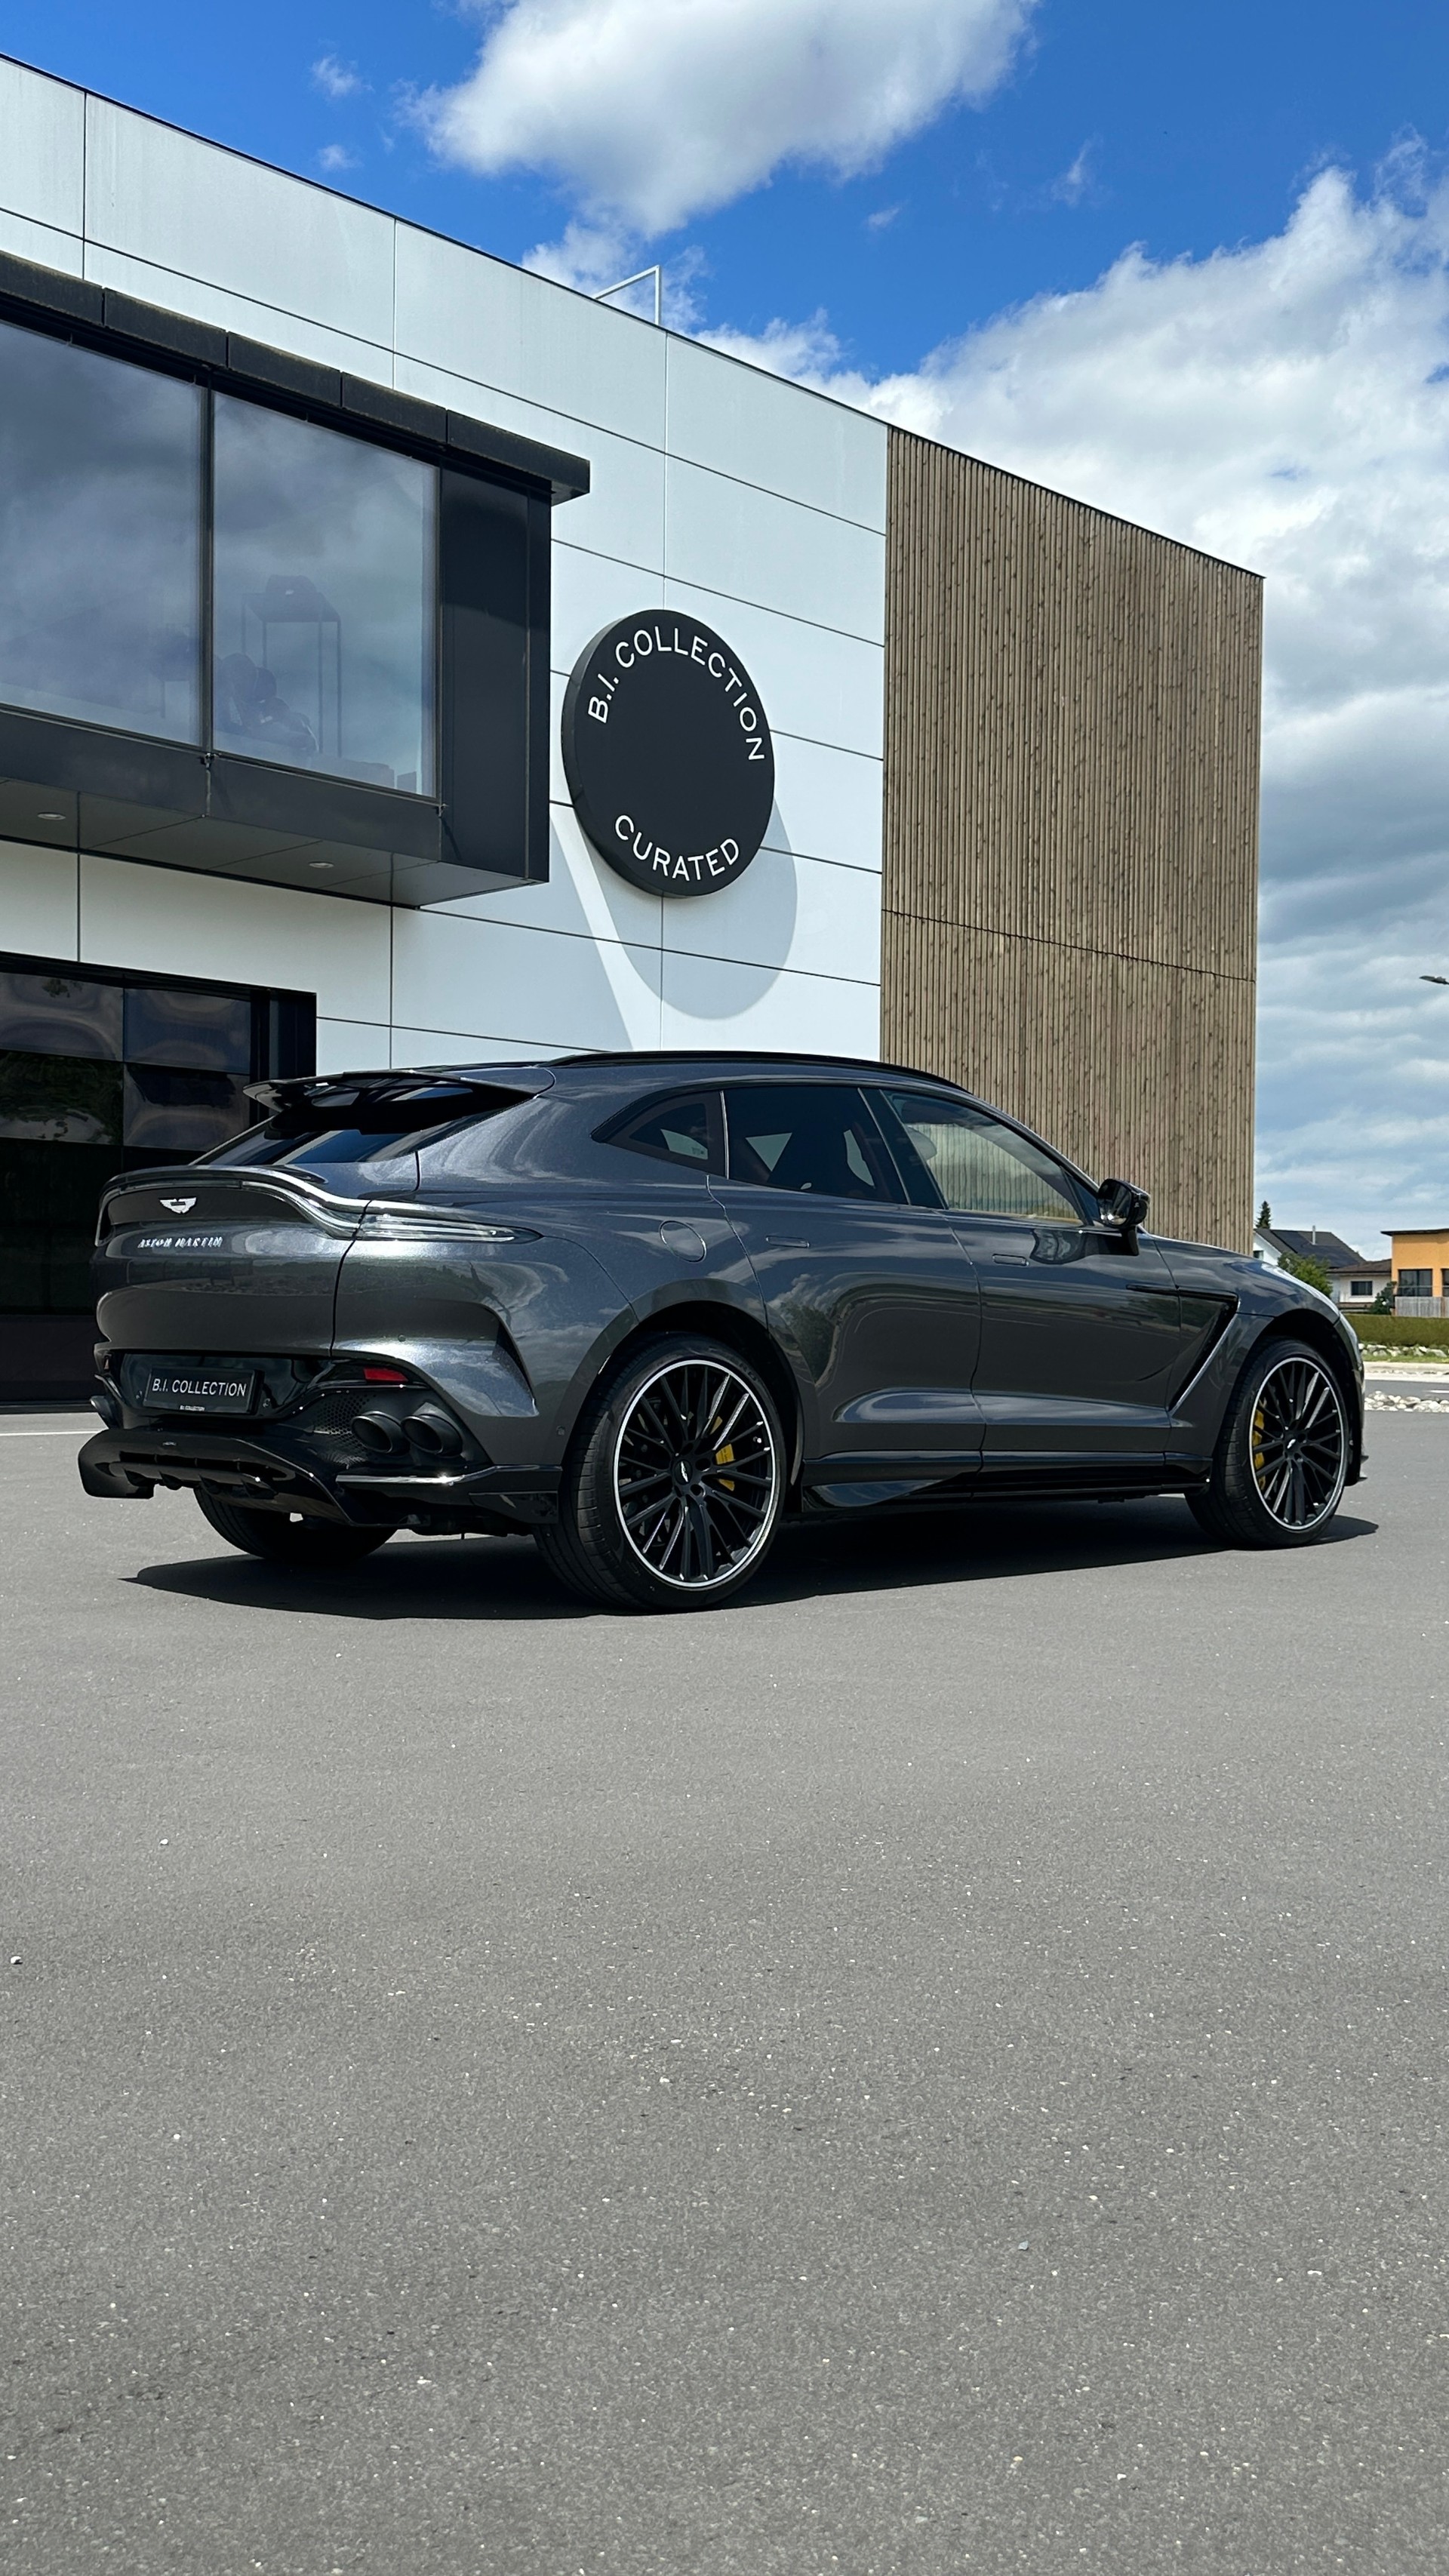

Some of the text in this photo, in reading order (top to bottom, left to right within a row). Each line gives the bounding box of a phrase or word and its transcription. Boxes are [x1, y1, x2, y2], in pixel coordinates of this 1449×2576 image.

[588, 626, 765, 760] B.I. COLLECTION
[614, 814, 739, 881] CURATED
[152, 1378, 247, 1397] B.I. COLLECTION
